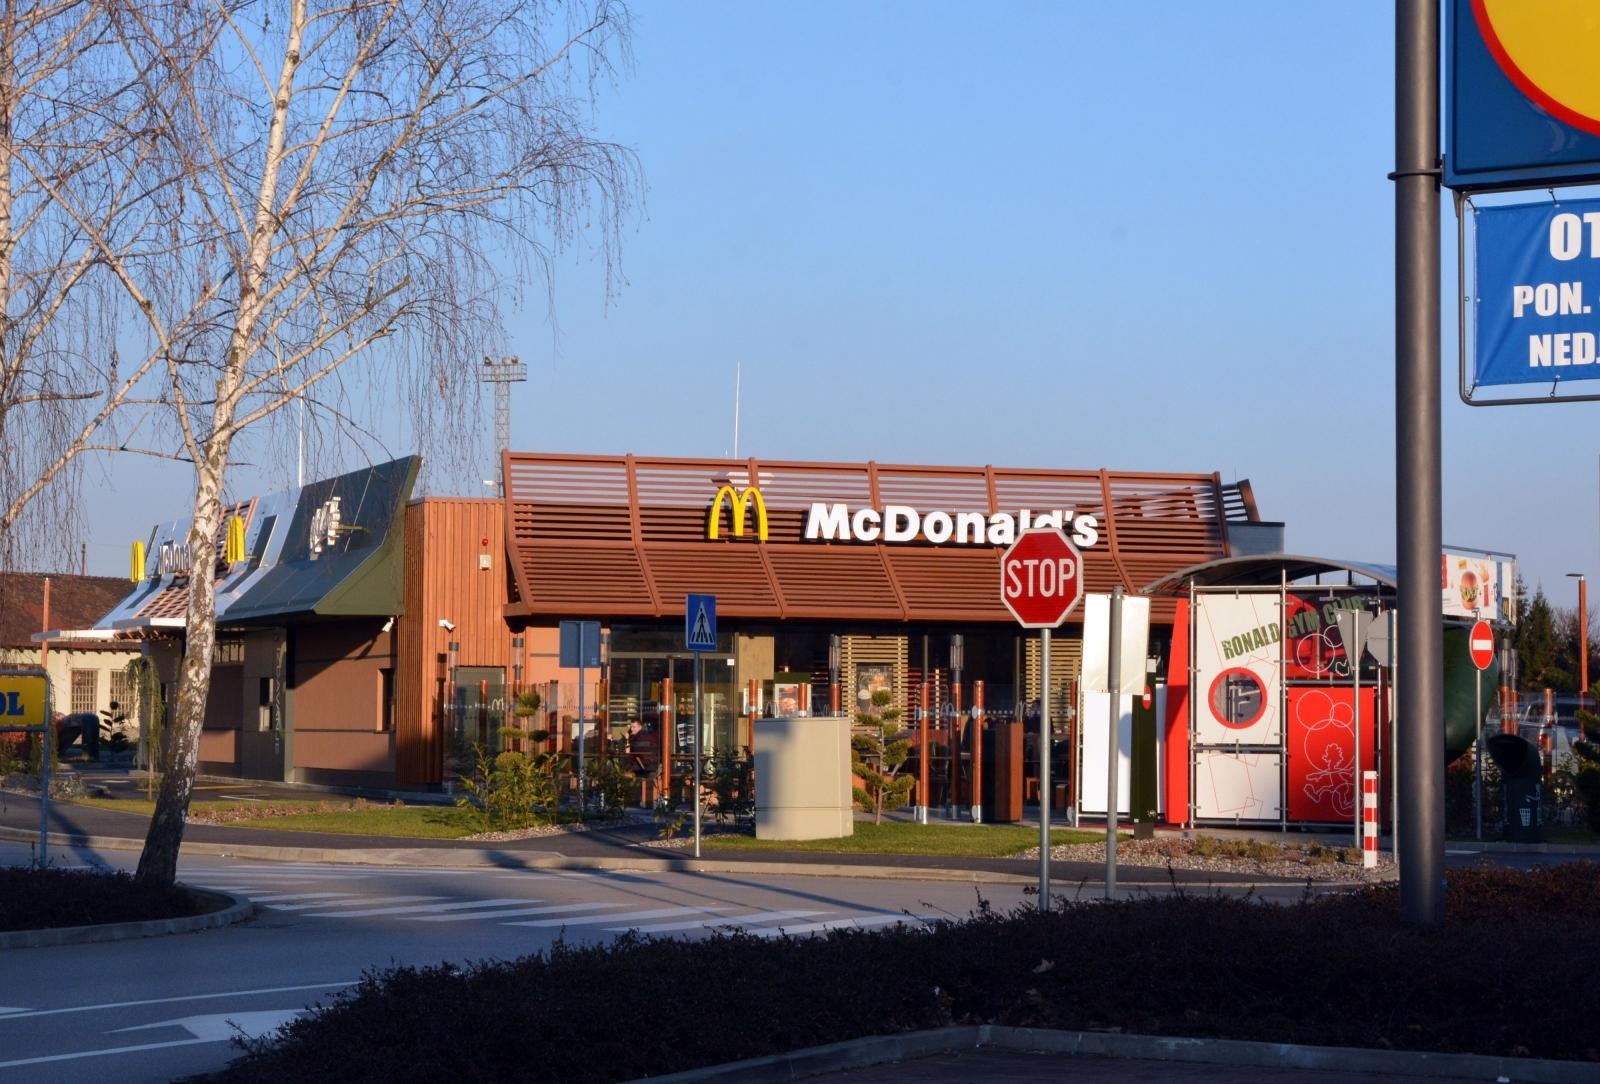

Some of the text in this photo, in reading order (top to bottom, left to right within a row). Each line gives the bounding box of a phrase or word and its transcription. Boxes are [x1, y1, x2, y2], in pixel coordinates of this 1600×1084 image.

[1513, 282, 1591, 317] PON.
[805, 503, 1098, 546] McDonald's
[1006, 558, 1075, 598] STOP
[1221, 622, 1280, 660] RONALD
